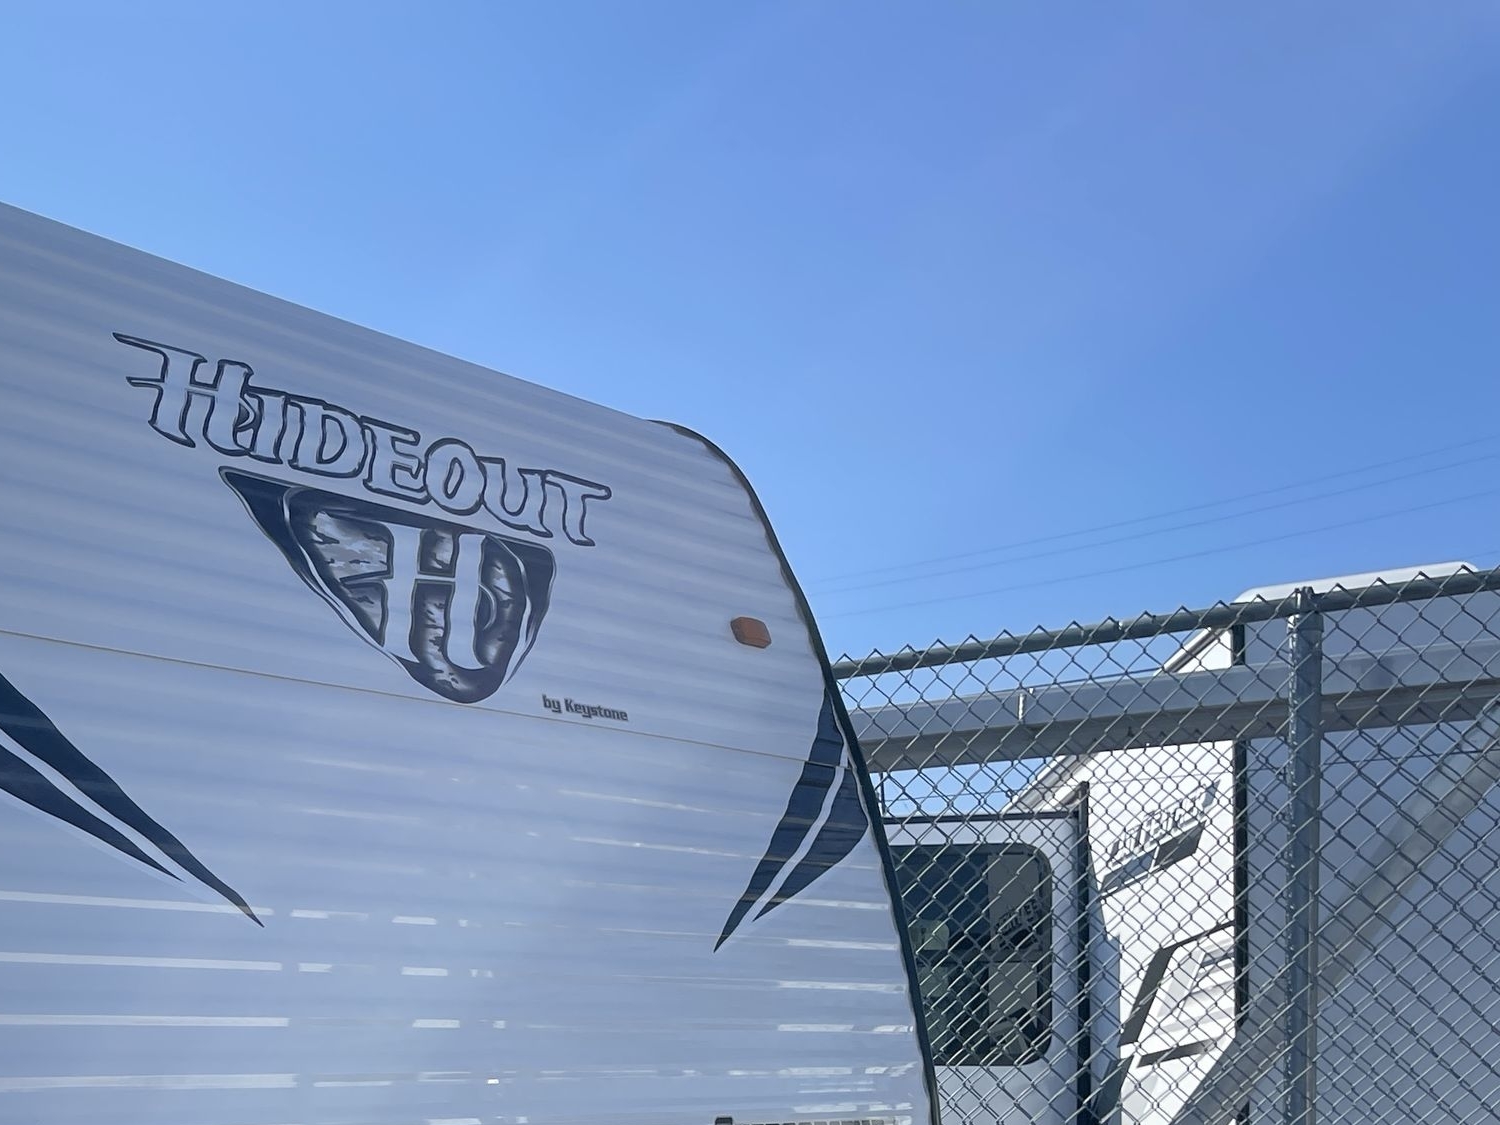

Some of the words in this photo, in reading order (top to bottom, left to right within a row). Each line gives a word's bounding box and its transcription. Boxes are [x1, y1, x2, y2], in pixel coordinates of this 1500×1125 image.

[112, 332, 612, 547] HIDEOUT
[542, 693, 562, 714] by
[564, 698, 629, 722] Keystone
